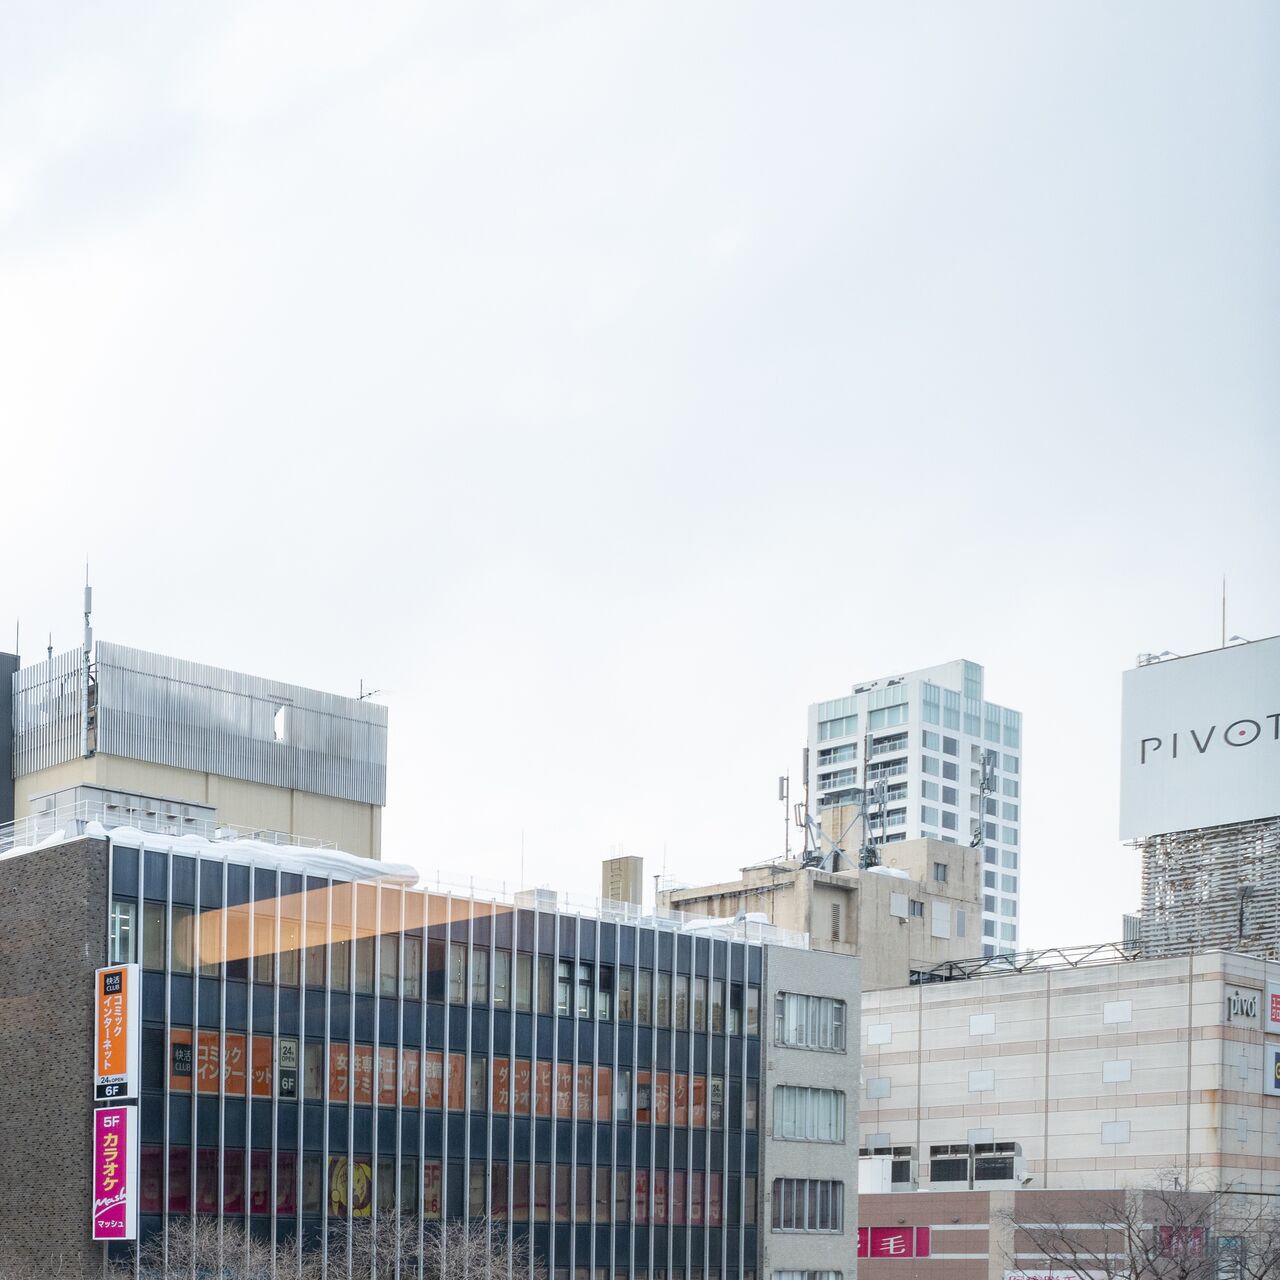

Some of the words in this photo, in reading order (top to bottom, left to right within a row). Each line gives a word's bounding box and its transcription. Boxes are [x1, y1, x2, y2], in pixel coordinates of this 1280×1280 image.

[114, 995, 122, 1037] コミック
[103, 996, 112, 1070] インターネット
[282, 1078, 294, 1090] 6F
[105, 1086, 119, 1096] 6F
[103, 1115, 120, 1128] 5F
[103, 1132, 119, 1190] カラオケ
[97, 1220, 124, 1229] マッシュ
